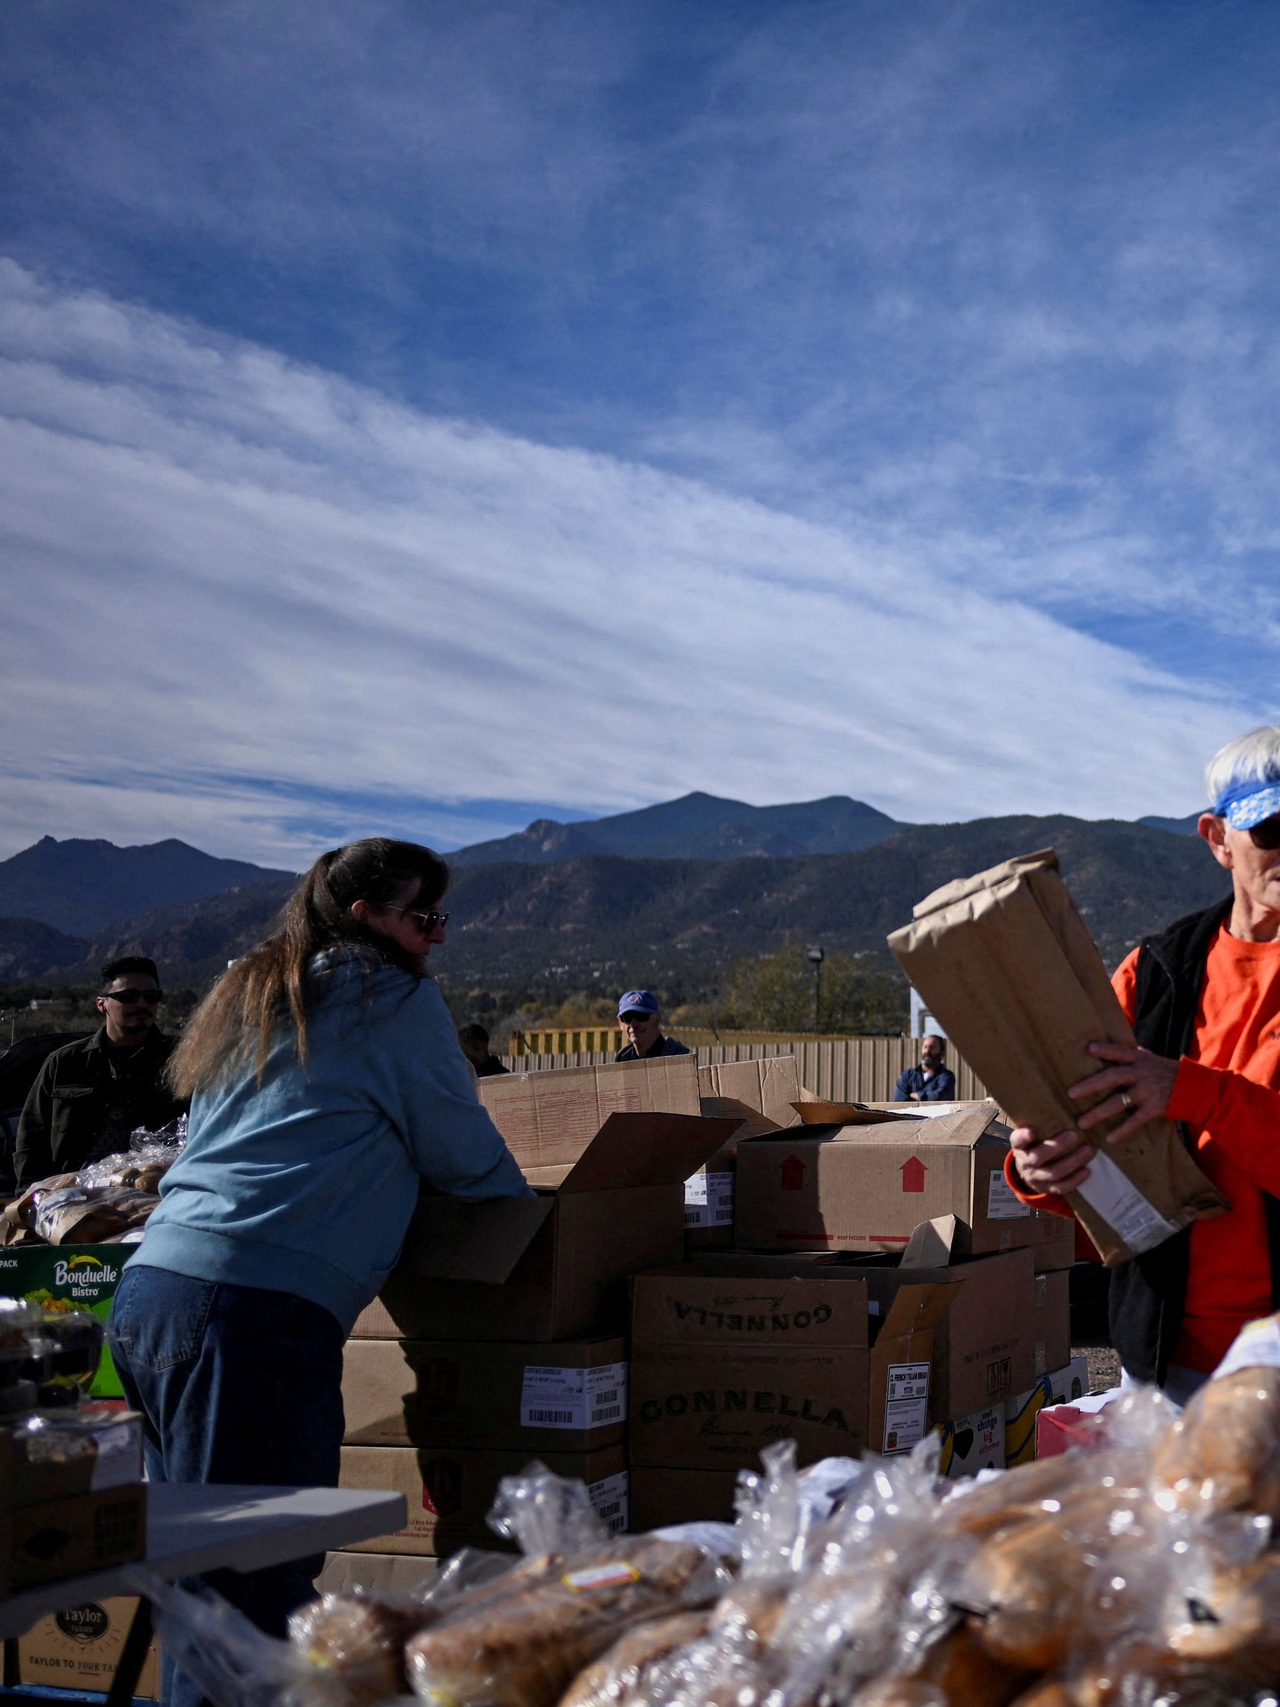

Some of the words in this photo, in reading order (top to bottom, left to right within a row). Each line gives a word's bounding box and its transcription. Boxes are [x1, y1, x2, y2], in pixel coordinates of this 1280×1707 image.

[53, 1260, 118, 1287] Bonduelle
[71, 1287, 100, 1297] Bistro
[673, 1300, 833, 1332] GONNELLA
[639, 1389, 849, 1434] GONNELLA
[977, 1416, 998, 1432] change
[64, 1607, 102, 1625] Taylor
[29, 1656, 61, 1668] TAYLOR
[62, 1658, 75, 1669] TO
[77, 1659, 101, 1672] YOUR
[101, 1663, 118, 1674] TAS
